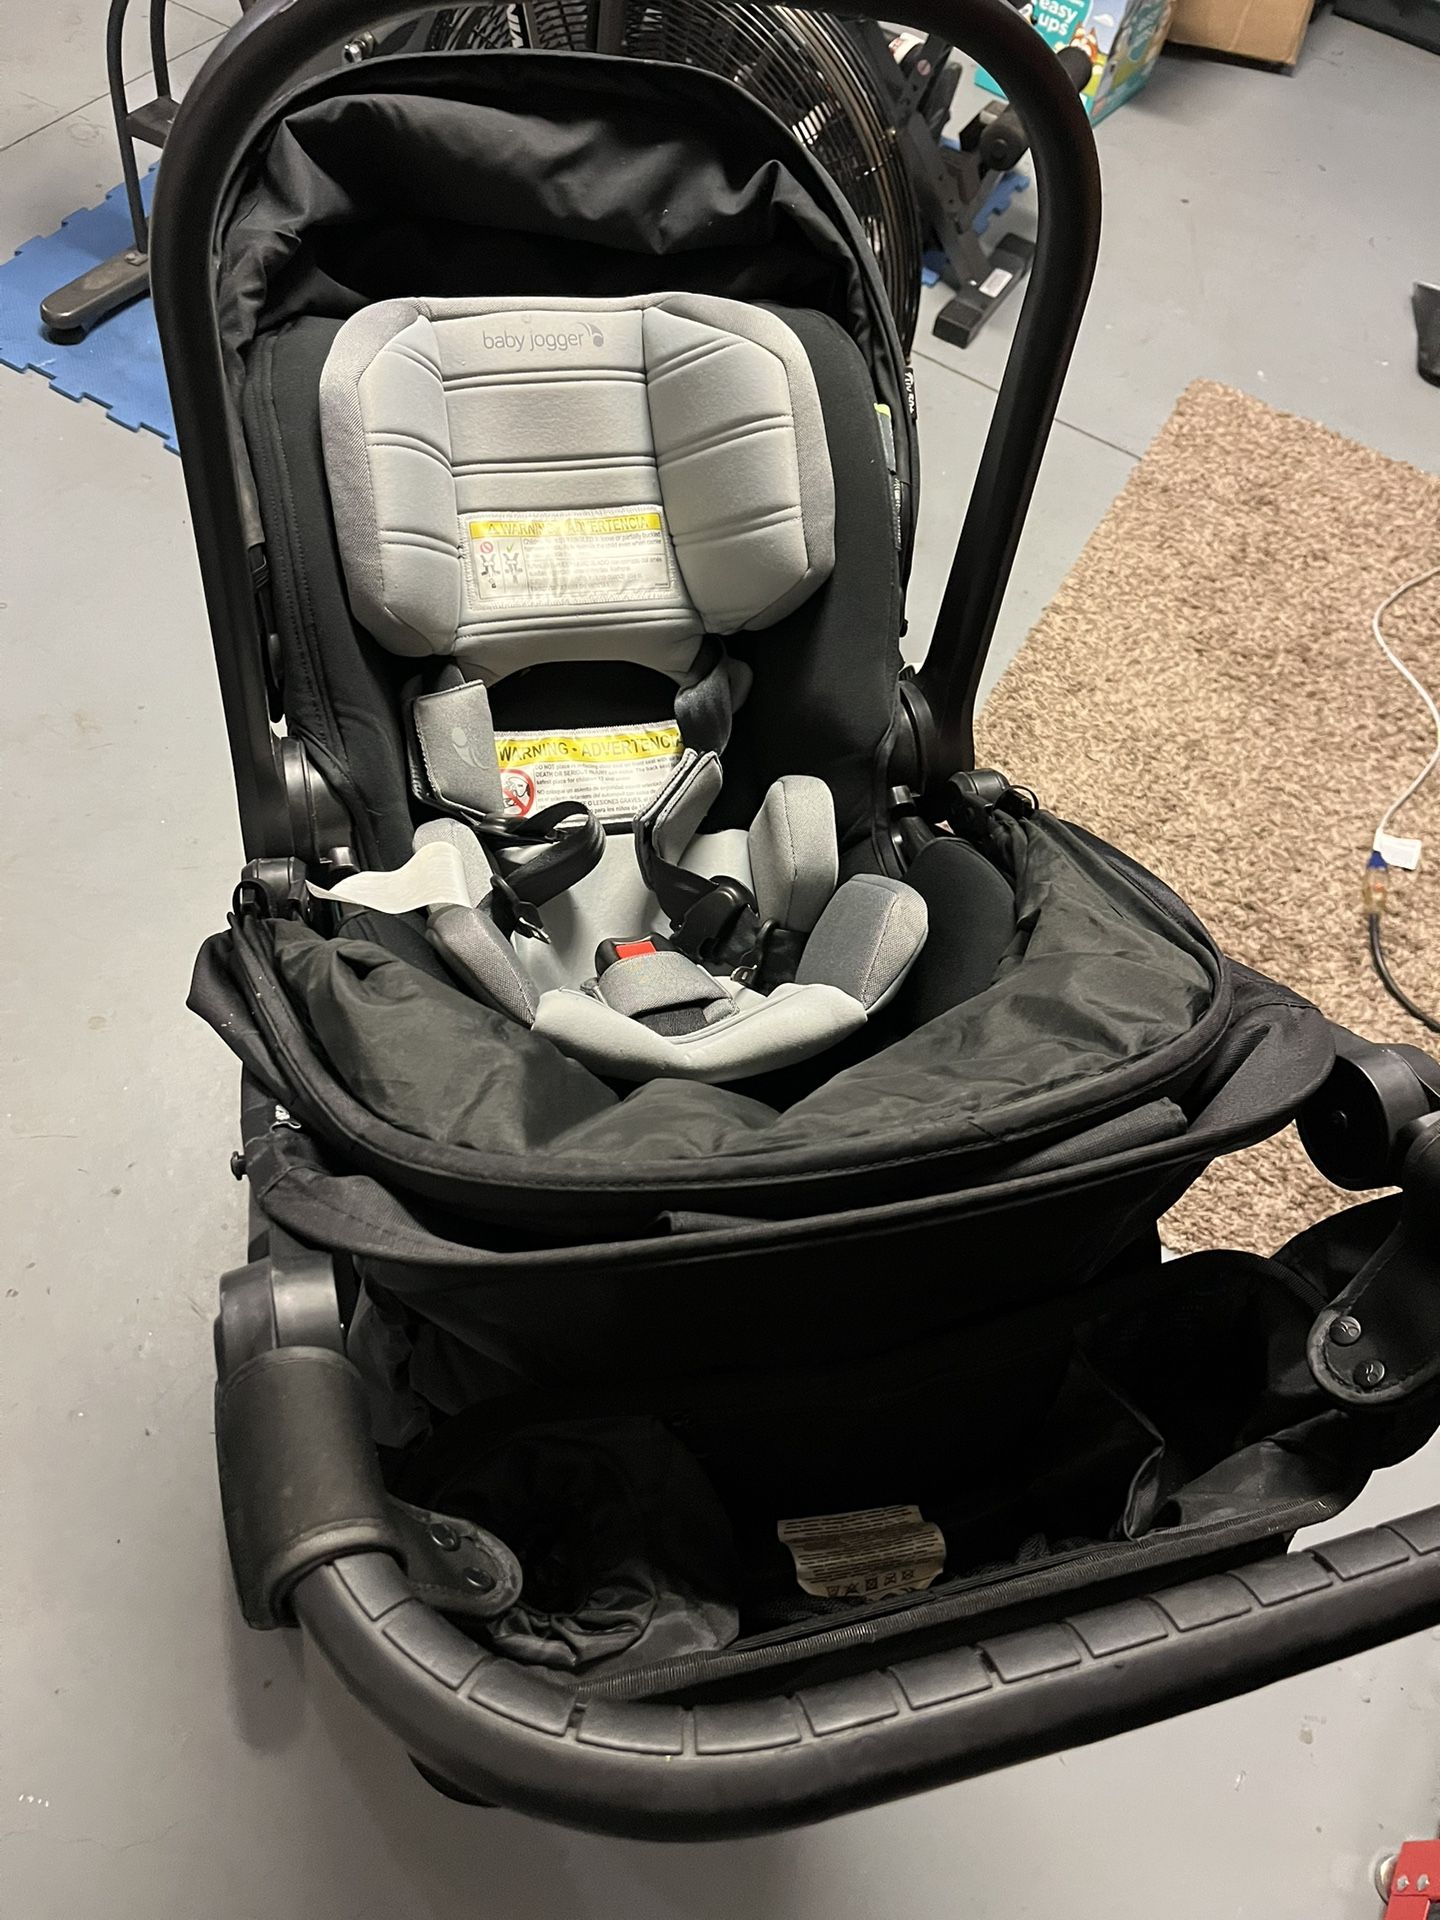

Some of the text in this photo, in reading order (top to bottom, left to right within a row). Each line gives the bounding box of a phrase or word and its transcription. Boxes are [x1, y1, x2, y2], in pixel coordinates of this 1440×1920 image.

[1039, 0, 1078, 22] easy
[1038, 13, 1070, 36] ups
[482, 331, 585, 352] baby jogger
[566, 516, 649, 535] ADERTENCIA
[500, 742, 569, 762] WARNING
